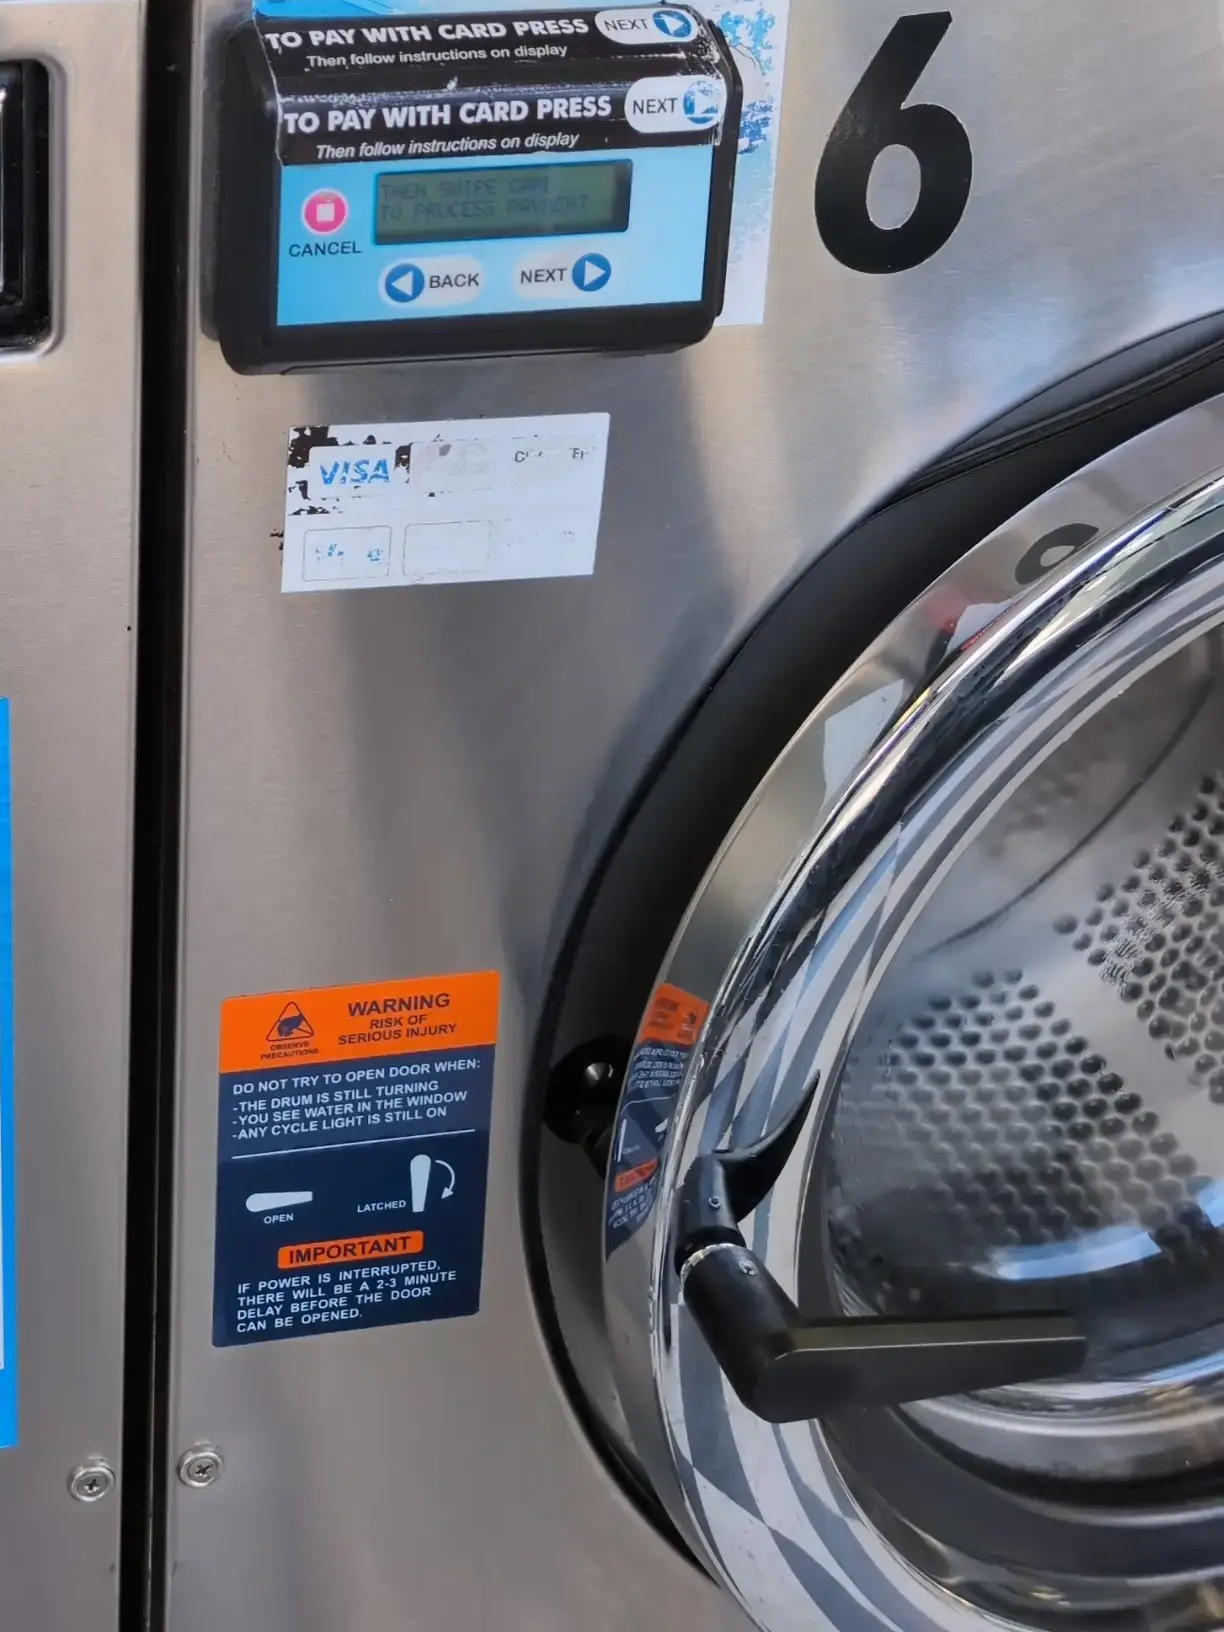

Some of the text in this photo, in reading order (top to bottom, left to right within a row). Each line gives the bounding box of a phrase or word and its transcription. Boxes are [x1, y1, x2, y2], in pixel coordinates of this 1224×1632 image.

[265, 18, 649, 50] TO PAY WITH CARD PRESS NEXT
[307, 42, 568, 68] Then follow instructions on display
[284, 96, 679, 133] TO PAY WITH CARD PRESS NEXT
[814, 10, 972, 275] 6
[288, 242, 362, 258] CANCEL
[429, 268, 567, 289] BACK NEXT
[319, 458, 390, 485] VISA
[347, 993, 450, 1017] WARNING
[338, 1023, 457, 1046] SERIOUS INJURY
[370, 1014, 427, 1029] RISK OF
[233, 1058, 480, 1095] DO NOT TRY TO OPEN DOOR WHEN:
[233, 1081, 439, 1114] -THE DRUM IS STILL TURNING
[289, 1235, 411, 1264] IMPORTANT
